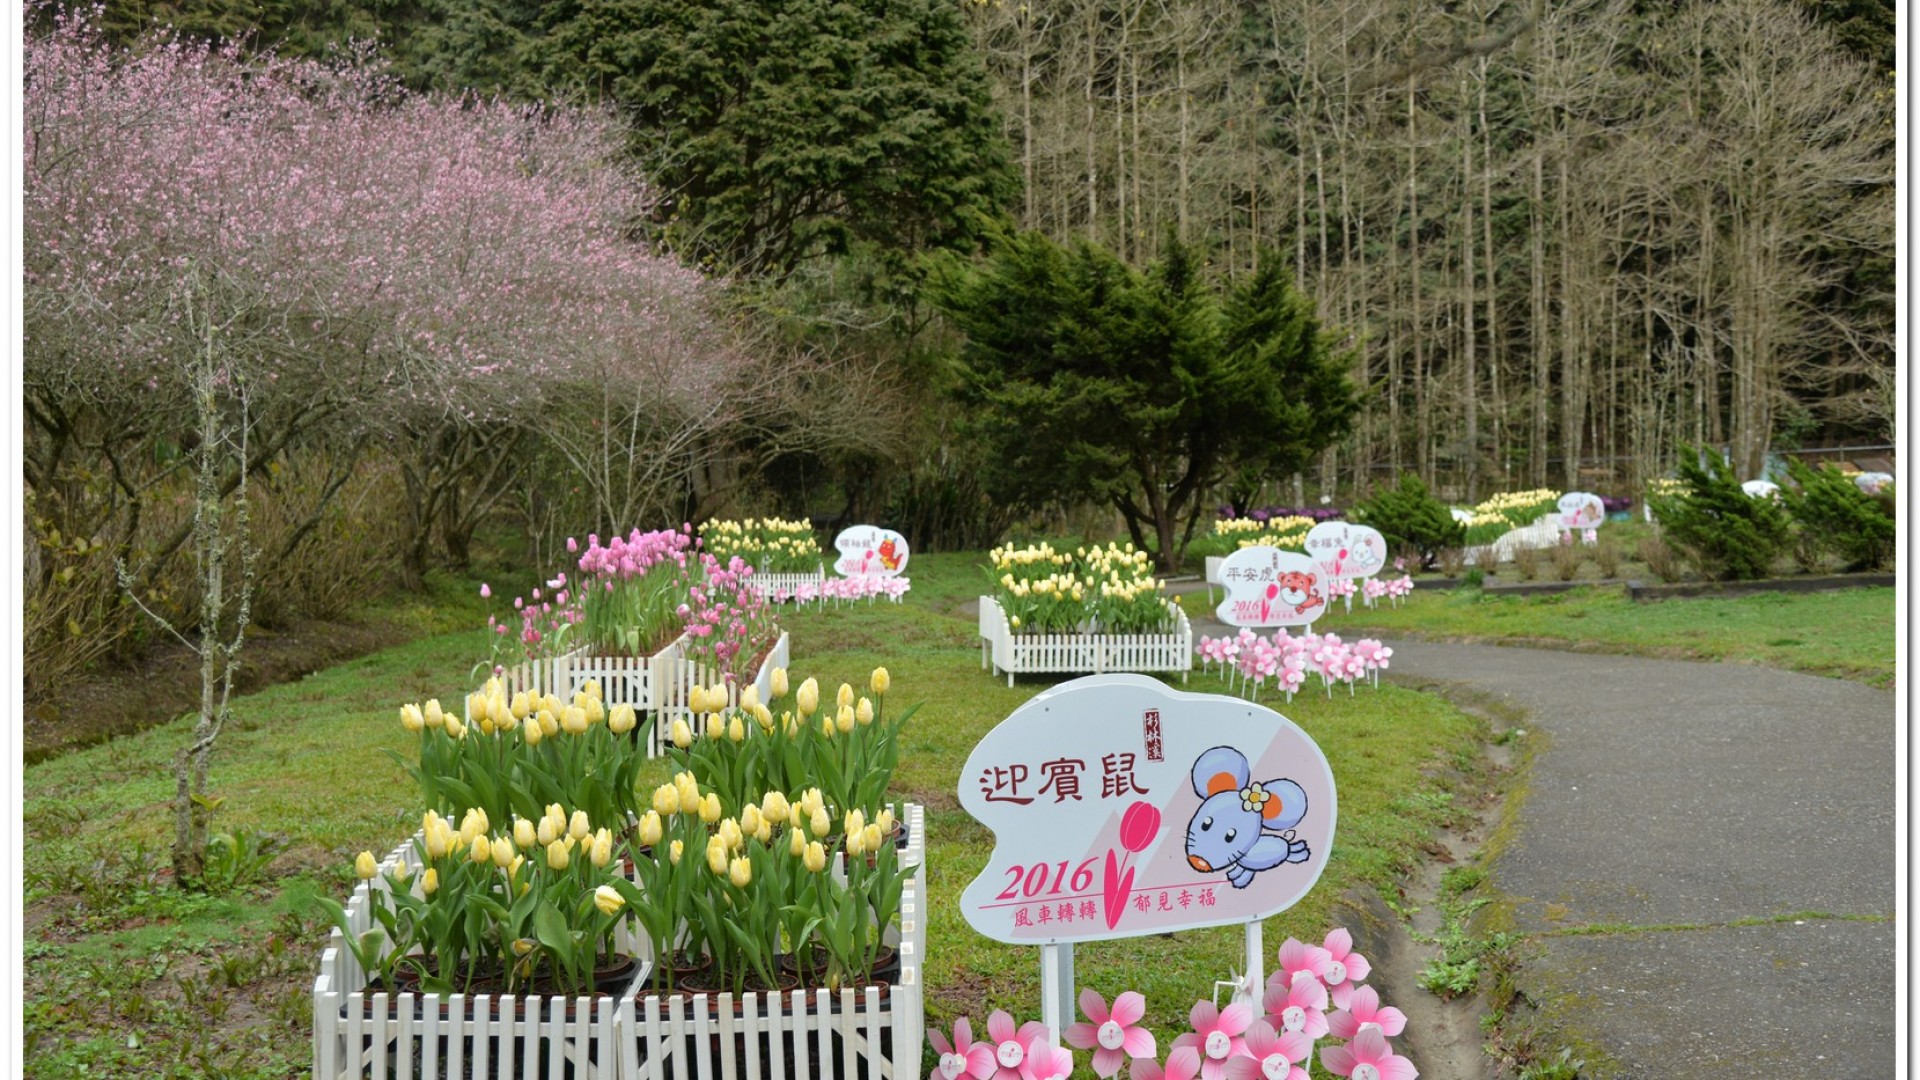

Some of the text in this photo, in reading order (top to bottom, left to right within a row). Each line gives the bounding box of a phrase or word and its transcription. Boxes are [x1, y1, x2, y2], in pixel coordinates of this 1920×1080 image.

[1226, 566, 1275, 582] 平安虎
[1231, 600, 1260, 612] 2016
[995, 856, 1100, 901] 2016
[1014, 900, 1097, 927] 風車轉轉
[1132, 888, 1216, 914] 郁見幸福
